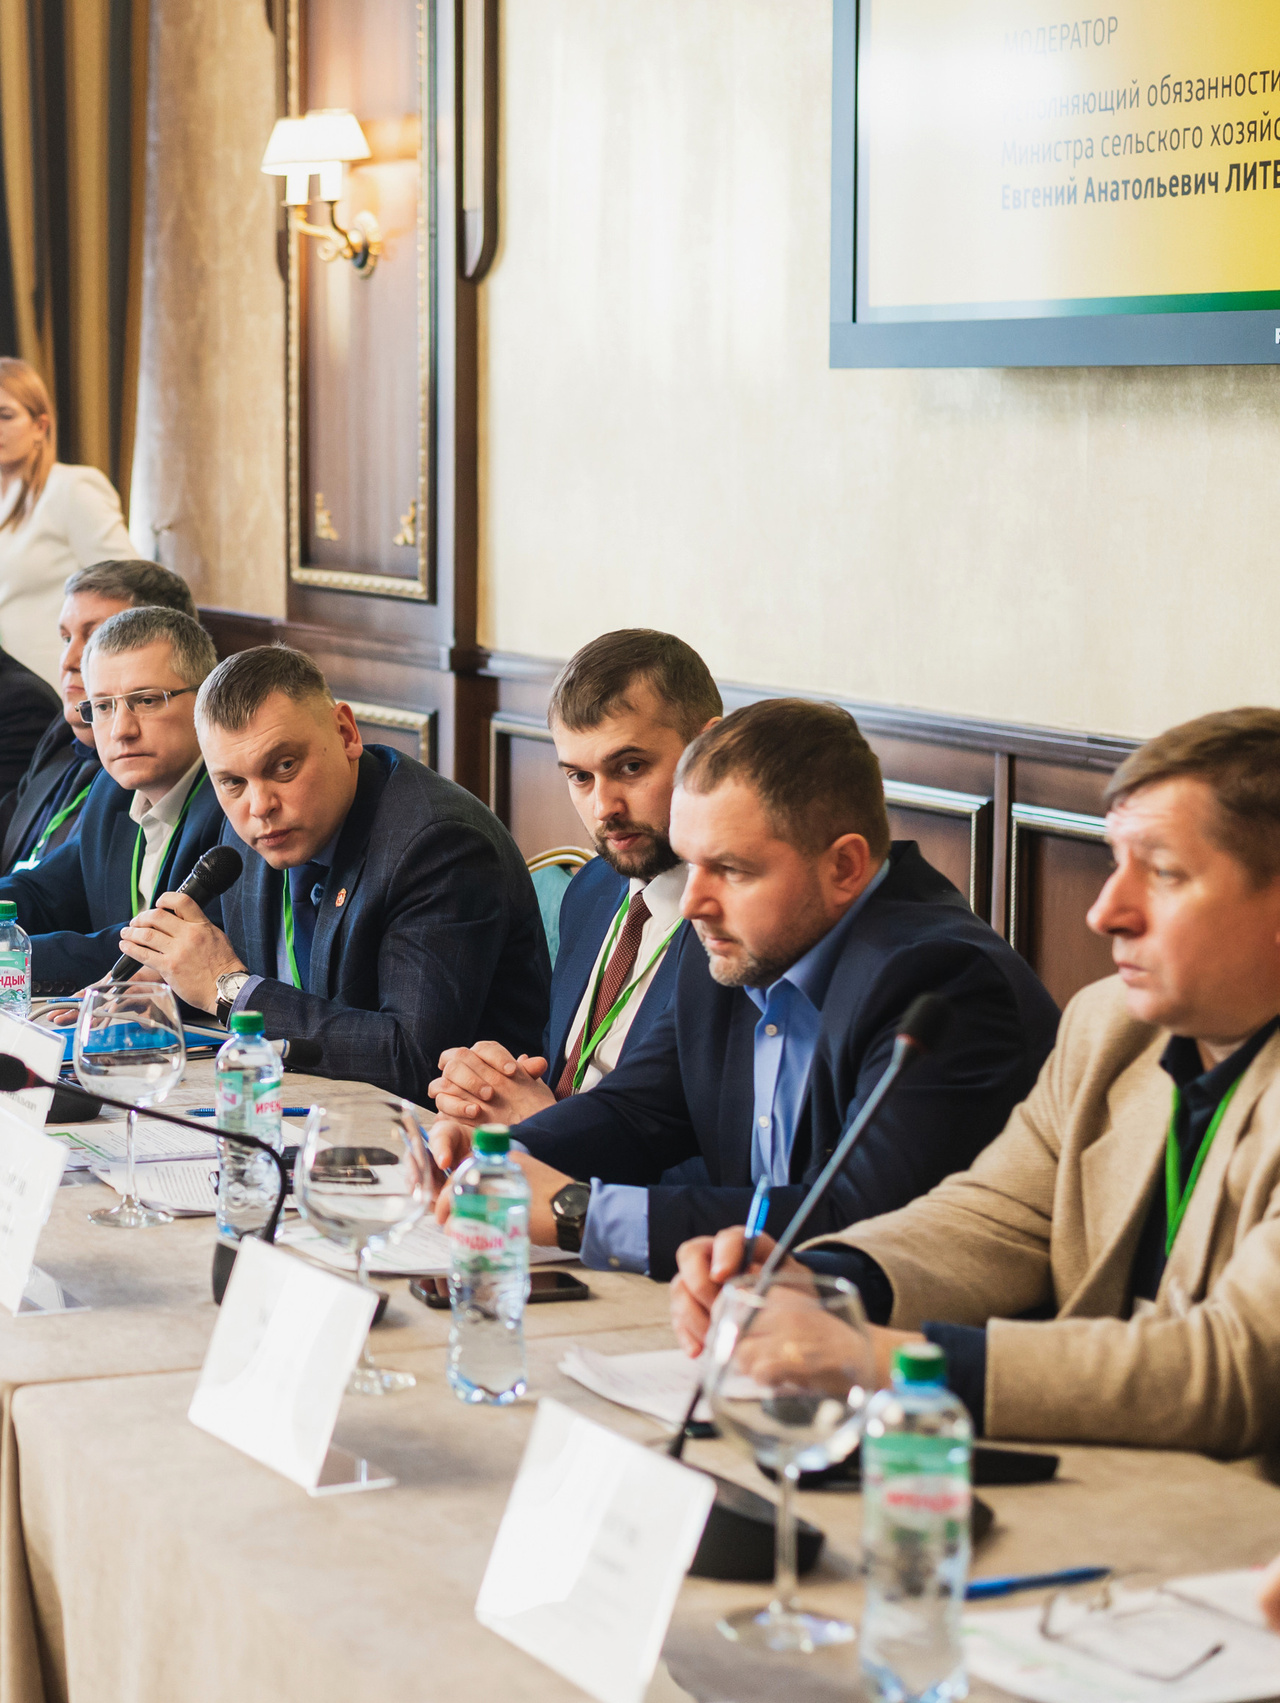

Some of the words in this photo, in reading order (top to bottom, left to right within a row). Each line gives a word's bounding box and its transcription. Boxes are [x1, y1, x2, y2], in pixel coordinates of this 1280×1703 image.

[1003, 16, 1119, 57] МОДЕРАТОР
[1002, 79, 1140, 124] полняющий
[1147, 69, 1280, 107] обязанности
[1001, 137, 1094, 168] Министра
[1101, 126, 1203, 158] сельского
[1001, 175, 1078, 210] Евгений
[1083, 171, 1219, 204] Анатольевич
